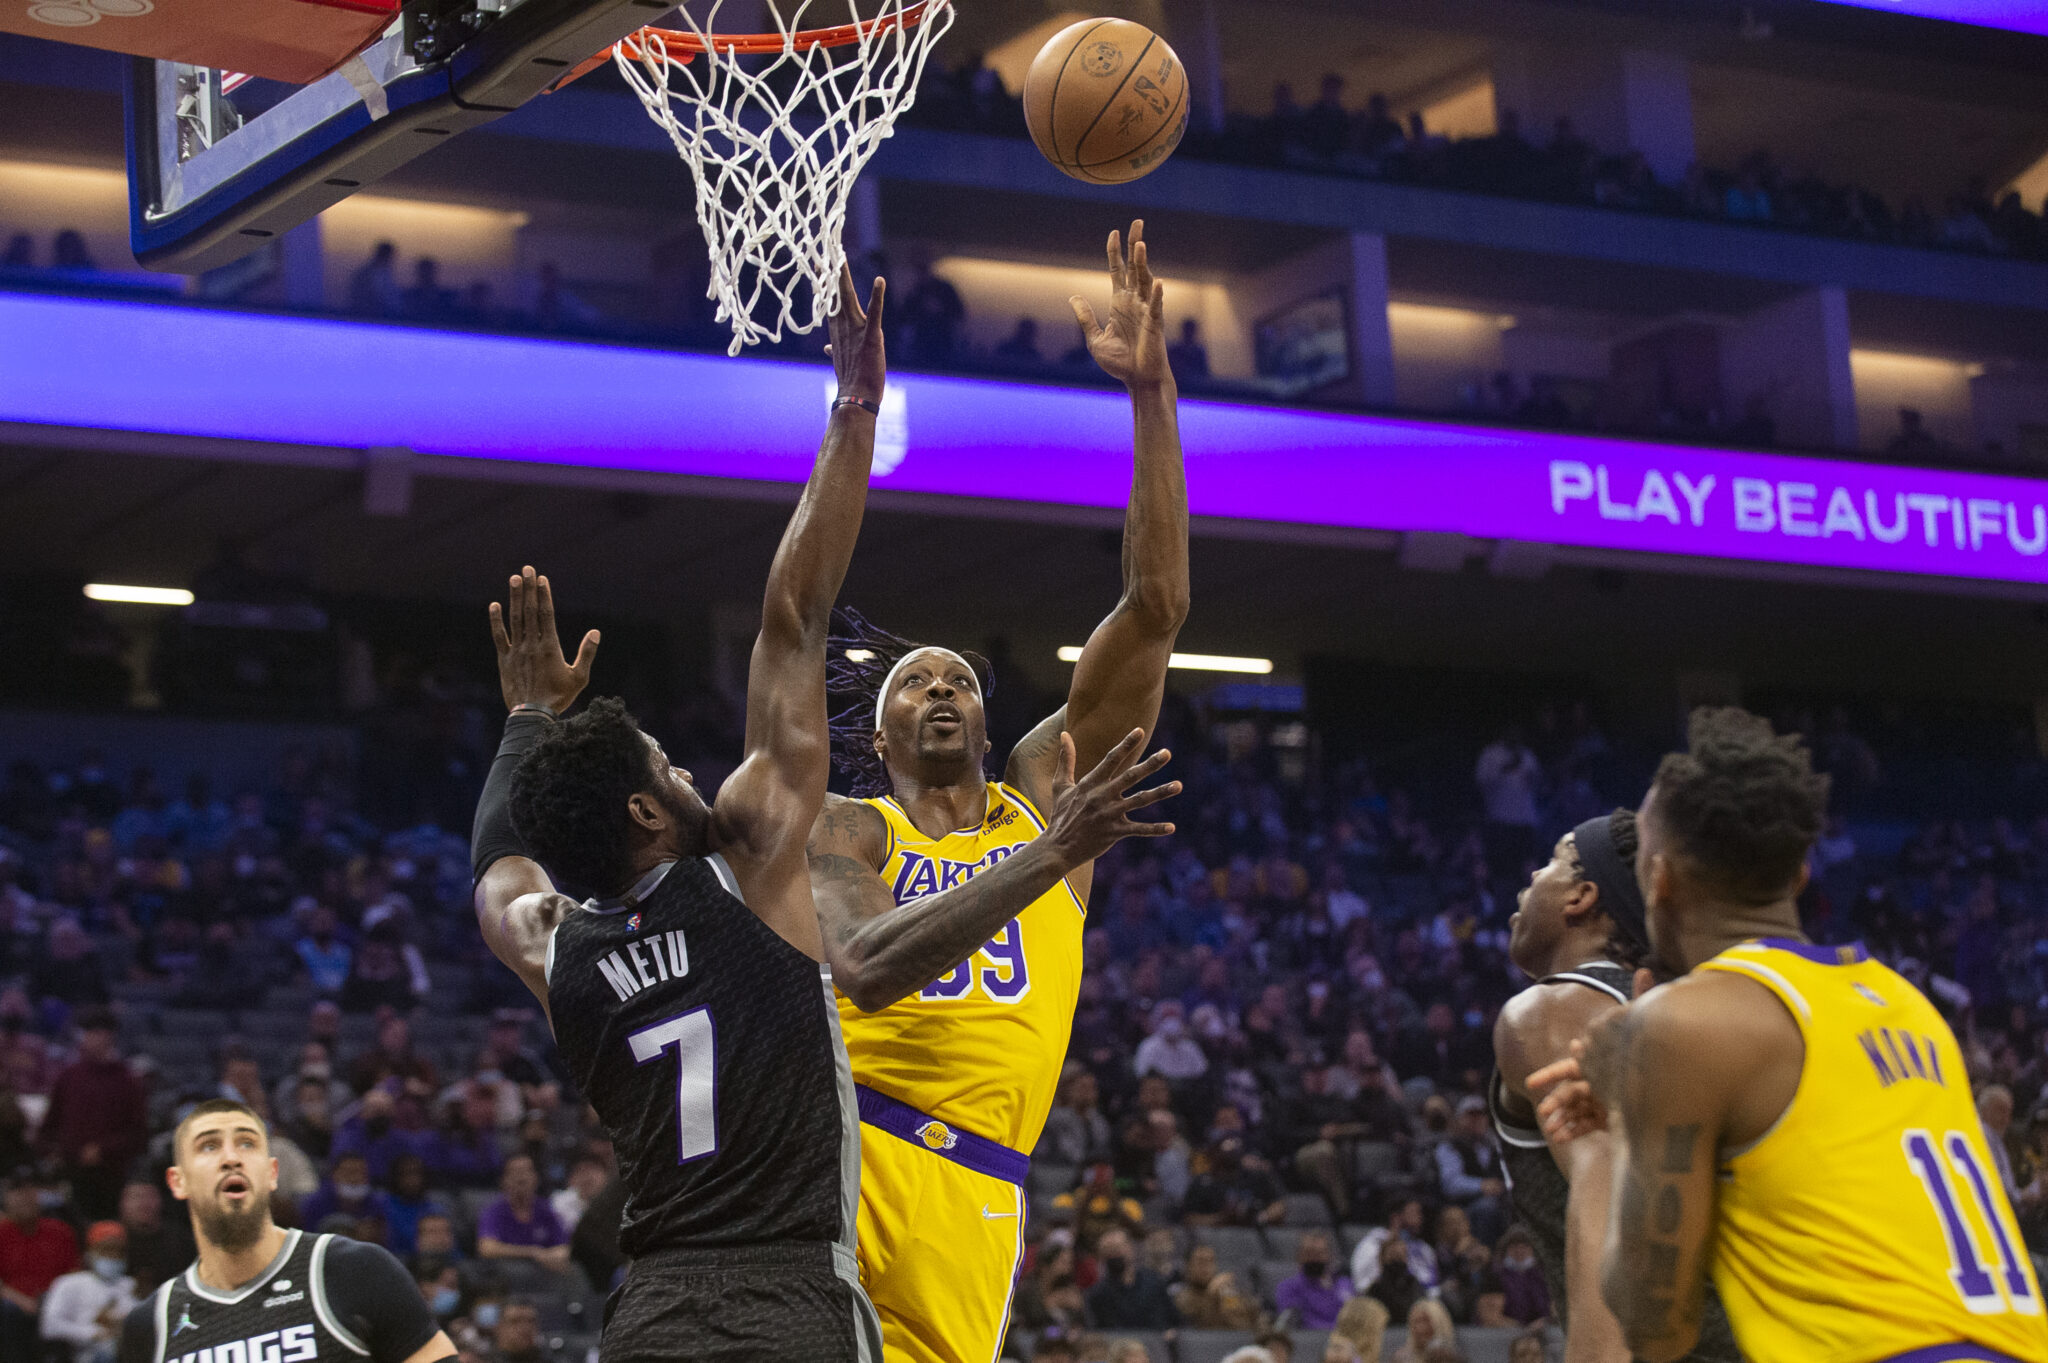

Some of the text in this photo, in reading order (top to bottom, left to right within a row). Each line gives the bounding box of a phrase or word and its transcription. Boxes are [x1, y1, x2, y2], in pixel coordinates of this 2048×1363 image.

[1549, 459, 2047, 557] PLAY BEAUTIFU
[982, 810, 1020, 836] bibigo
[892, 841, 1029, 907] LAKE
[596, 929, 690, 1002] METU
[626, 1003, 719, 1165] 7
[915, 1122, 957, 1149] LAKERS
[1901, 1128, 2041, 1316] 11
[166, 1323, 318, 1363] NGS
